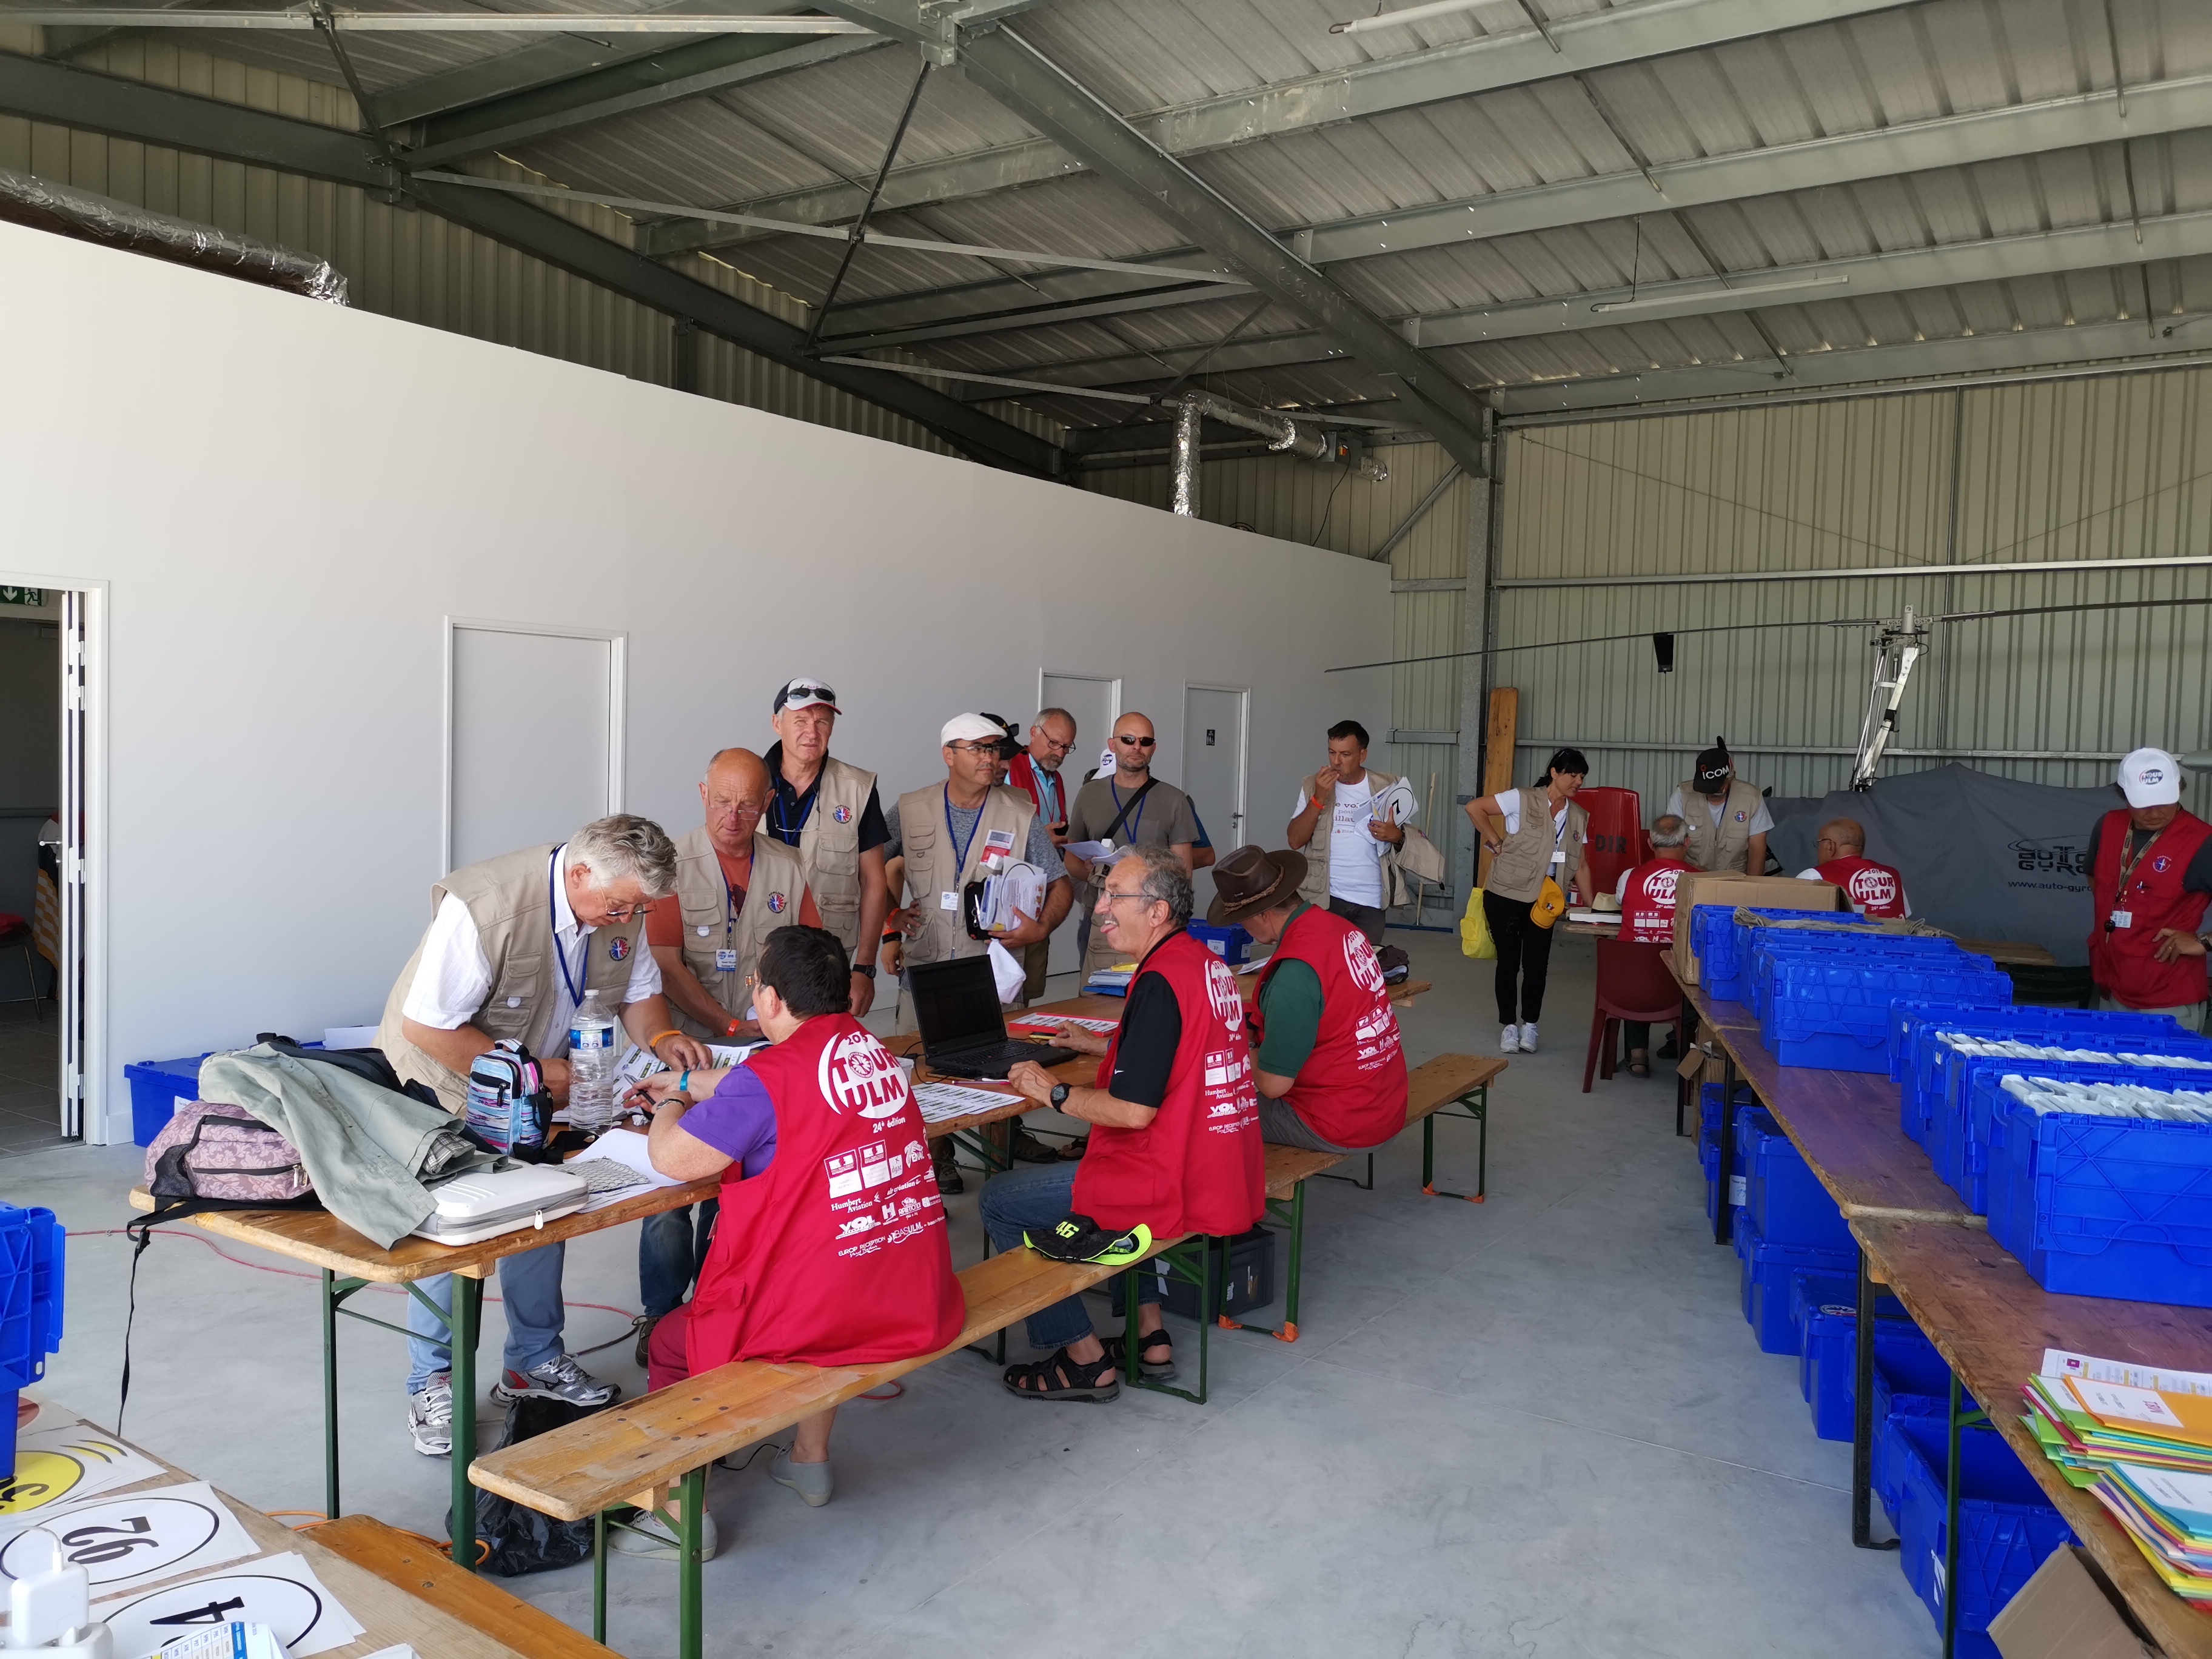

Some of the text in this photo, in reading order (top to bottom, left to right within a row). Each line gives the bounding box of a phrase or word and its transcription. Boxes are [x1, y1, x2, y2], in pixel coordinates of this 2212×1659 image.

[1595, 834, 1627, 854] DIR
[1856, 877, 1894, 889] TOUR
[1859, 888, 1892, 900] ULM
[832, 1047, 900, 1084] TOUR
[844, 1074, 905, 1111] ULM
[831, 1198, 862, 1212] Humbert
[847, 1201, 873, 1213] Aviation
[1056, 1221, 1079, 1239] 46
